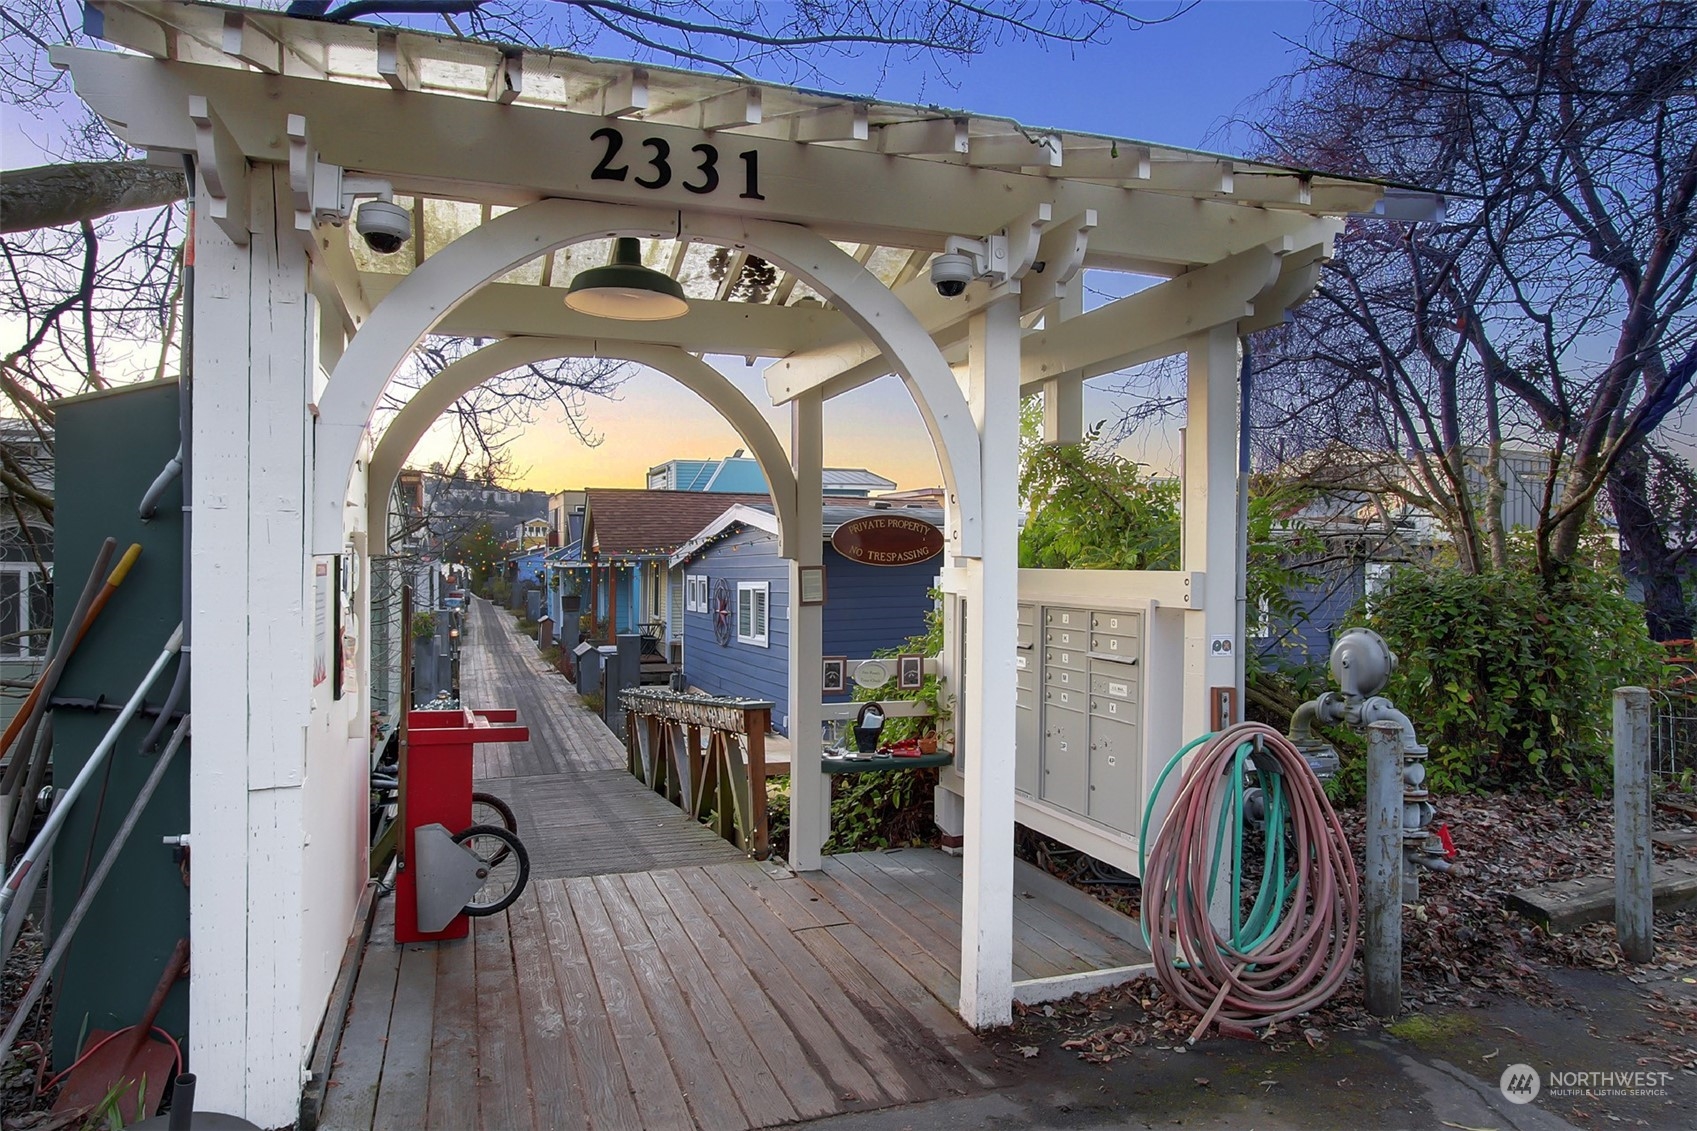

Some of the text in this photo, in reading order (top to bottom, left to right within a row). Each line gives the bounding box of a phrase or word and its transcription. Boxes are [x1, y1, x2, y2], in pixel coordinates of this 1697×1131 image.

[590, 127, 765, 200] 2331
[848, 519, 931, 535] PRIVATE PROPERTY
[848, 545, 929, 562] NO TRESPASSING
